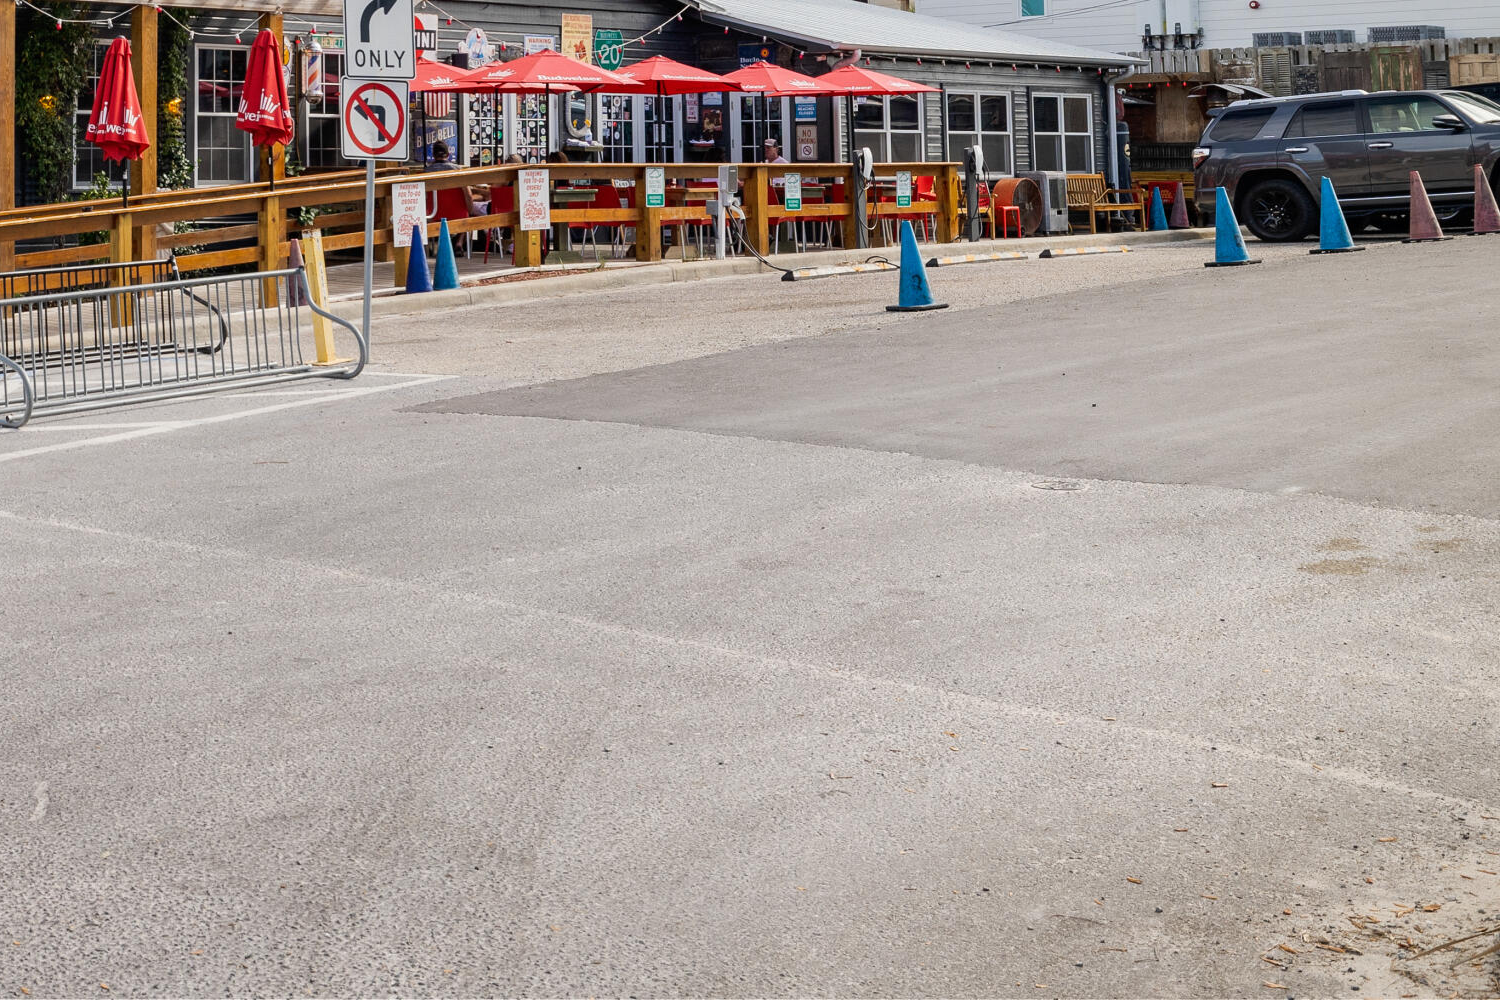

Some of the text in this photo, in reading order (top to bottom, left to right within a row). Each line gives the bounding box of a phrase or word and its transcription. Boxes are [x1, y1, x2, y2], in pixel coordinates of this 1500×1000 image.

[354, 48, 406, 69] ONLY
[600, 43, 620, 65] 20
[537, 74, 602, 82] Budweiser
[416, 124, 456, 149] BUE BELL
[802, 129, 812, 138] NO
